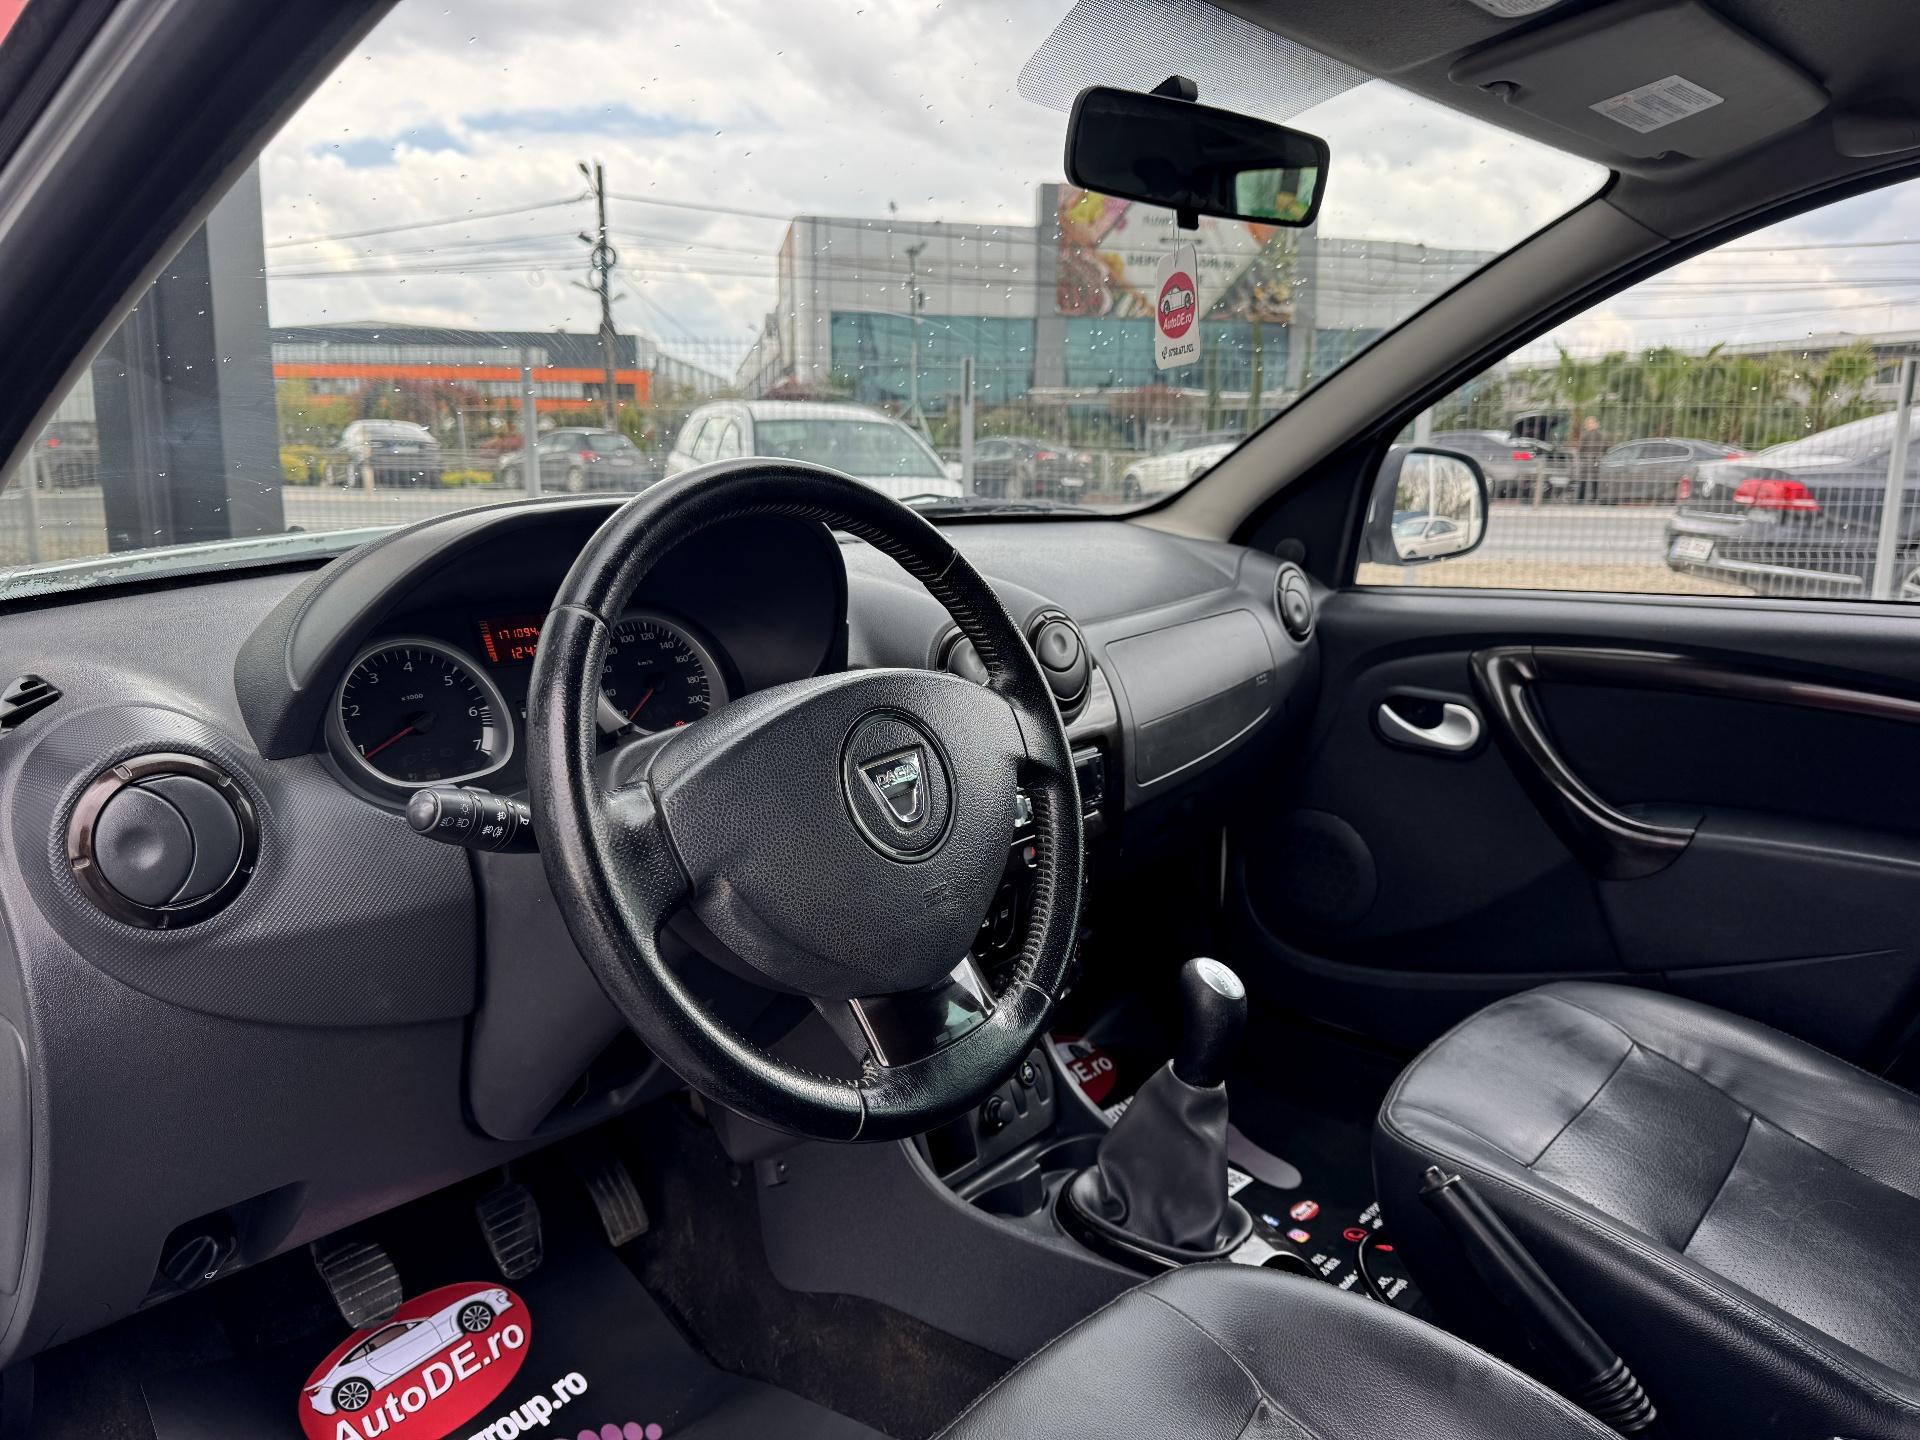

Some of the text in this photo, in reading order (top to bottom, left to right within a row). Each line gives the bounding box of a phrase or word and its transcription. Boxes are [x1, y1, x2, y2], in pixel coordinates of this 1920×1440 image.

[1163, 313, 1192, 330] AutoDE.ro
[620, 635, 635, 643] 100
[640, 632, 654, 640] 120
[659, 641, 674, 649] 140
[403, 661, 413, 672] 4
[369, 673, 379, 684] 3
[444, 676, 454, 686] 5
[687, 695, 704, 704] 200
[350, 706, 361, 716] 2
[468, 706, 478, 717] 6
[357, 744, 366, 755] 1
[472, 739, 482, 751] 7
[875, 762, 918, 787] DACIA
[1070, 1057, 1113, 1083] E.ro
[334, 1324, 524, 1440] AutoDE.ro
